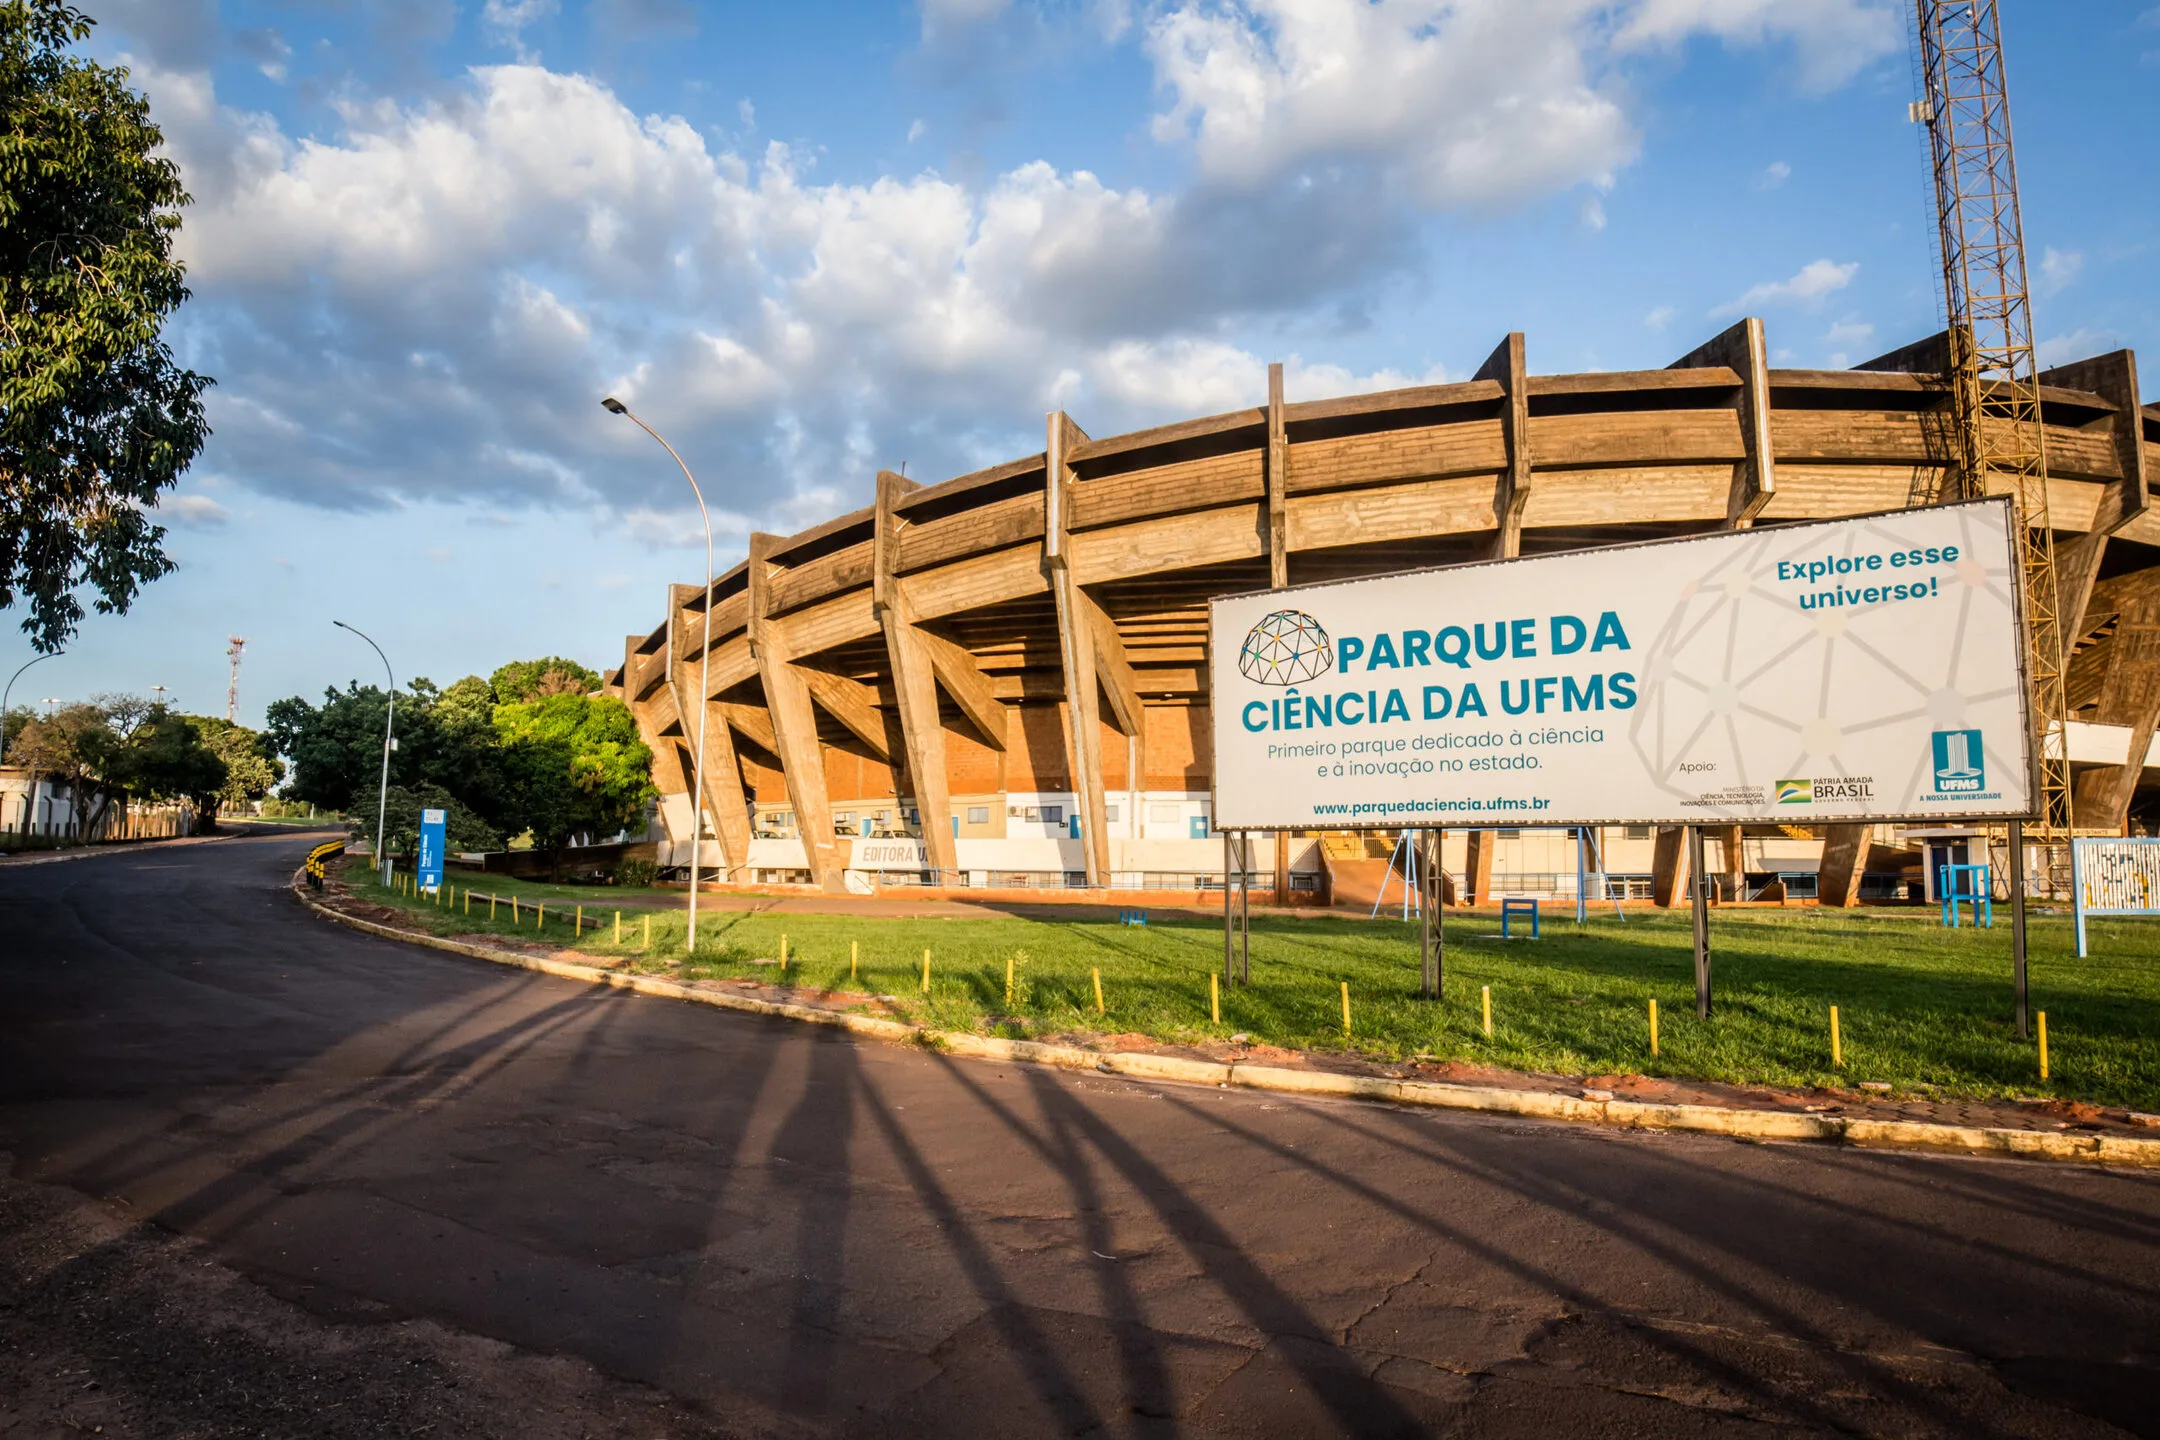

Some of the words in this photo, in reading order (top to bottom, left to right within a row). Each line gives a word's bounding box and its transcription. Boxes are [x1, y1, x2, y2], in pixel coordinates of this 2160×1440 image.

[1777, 554, 1882, 584] Explore
[1890, 546, 1959, 568] esse
[1799, 576, 1938, 610] universo!
[1338, 618, 1536, 673] PARQUE
[1550, 611, 1631, 655] DA
[1242, 687, 1411, 732] CIÊNCIA
[1423, 683, 1488, 720] DA
[1500, 672, 1637, 715] UFMS
[1268, 740, 1336, 758] Primeiro
[1342, 738, 1406, 758] parque
[1412, 731, 1504, 750] dedicado
[1510, 729, 1522, 746] à
[1528, 726, 1604, 744] ciência
[1318, 766, 1328, 777] e
[1333, 762, 1344, 776] à
[1350, 758, 1434, 778] inovação
[1440, 759, 1464, 772] no
[1469, 753, 1543, 770] estado.
[1679, 761, 1717, 774] Apoio:
[1814, 784, 1874, 798] BRASIL
[1940, 779, 1979, 790] UFMS
[1313, 796, 1550, 816] www.parquedaciencia.ufms.br
[1950, 792, 2002, 800] UNIVERSIDADE
[863, 846, 913, 862] EDITORA
